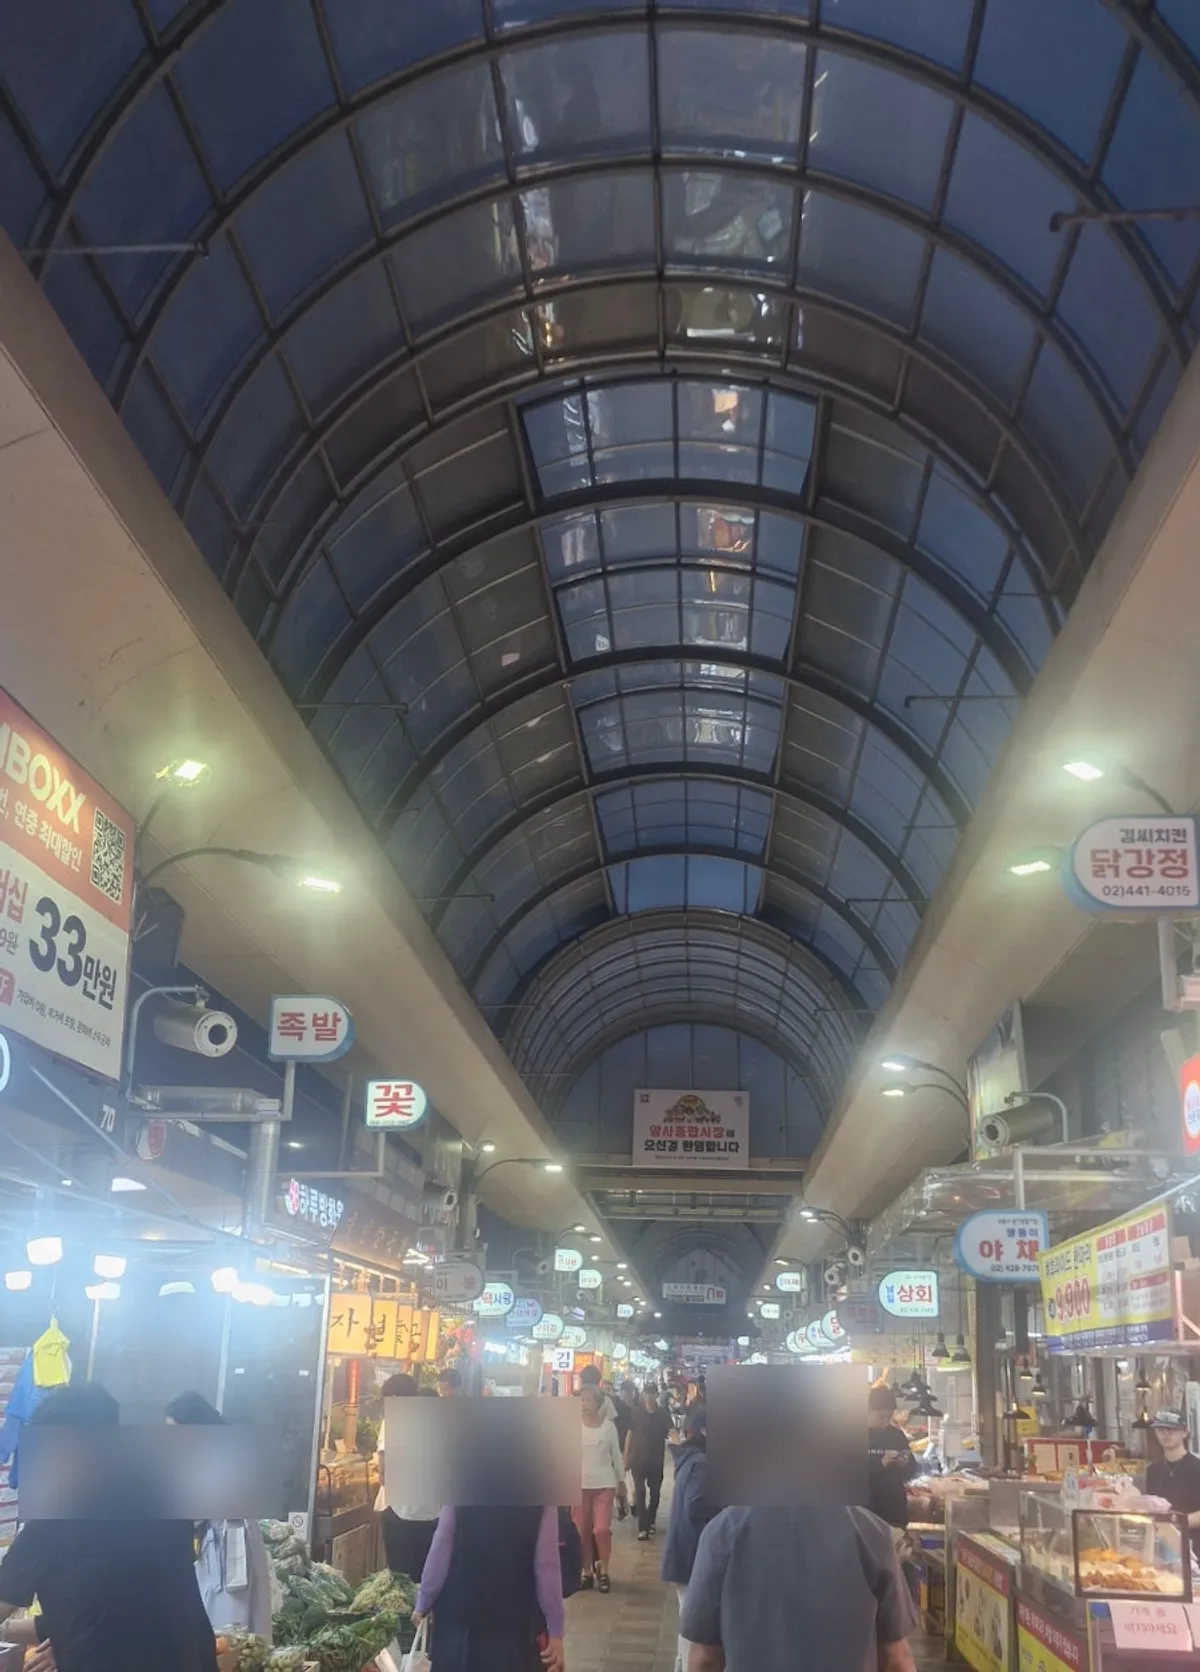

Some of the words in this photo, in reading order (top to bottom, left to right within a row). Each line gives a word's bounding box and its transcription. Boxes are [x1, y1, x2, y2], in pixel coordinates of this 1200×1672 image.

[14, 799, 39, 836] 연중
[39, 819, 83, 873] 최대할인
[1090, 848, 1190, 879] 닭강정
[277, 1011, 342, 1041] 족발
[373, 1084, 416, 1118] 꽃
[897, 1284, 933, 1303] 상회
